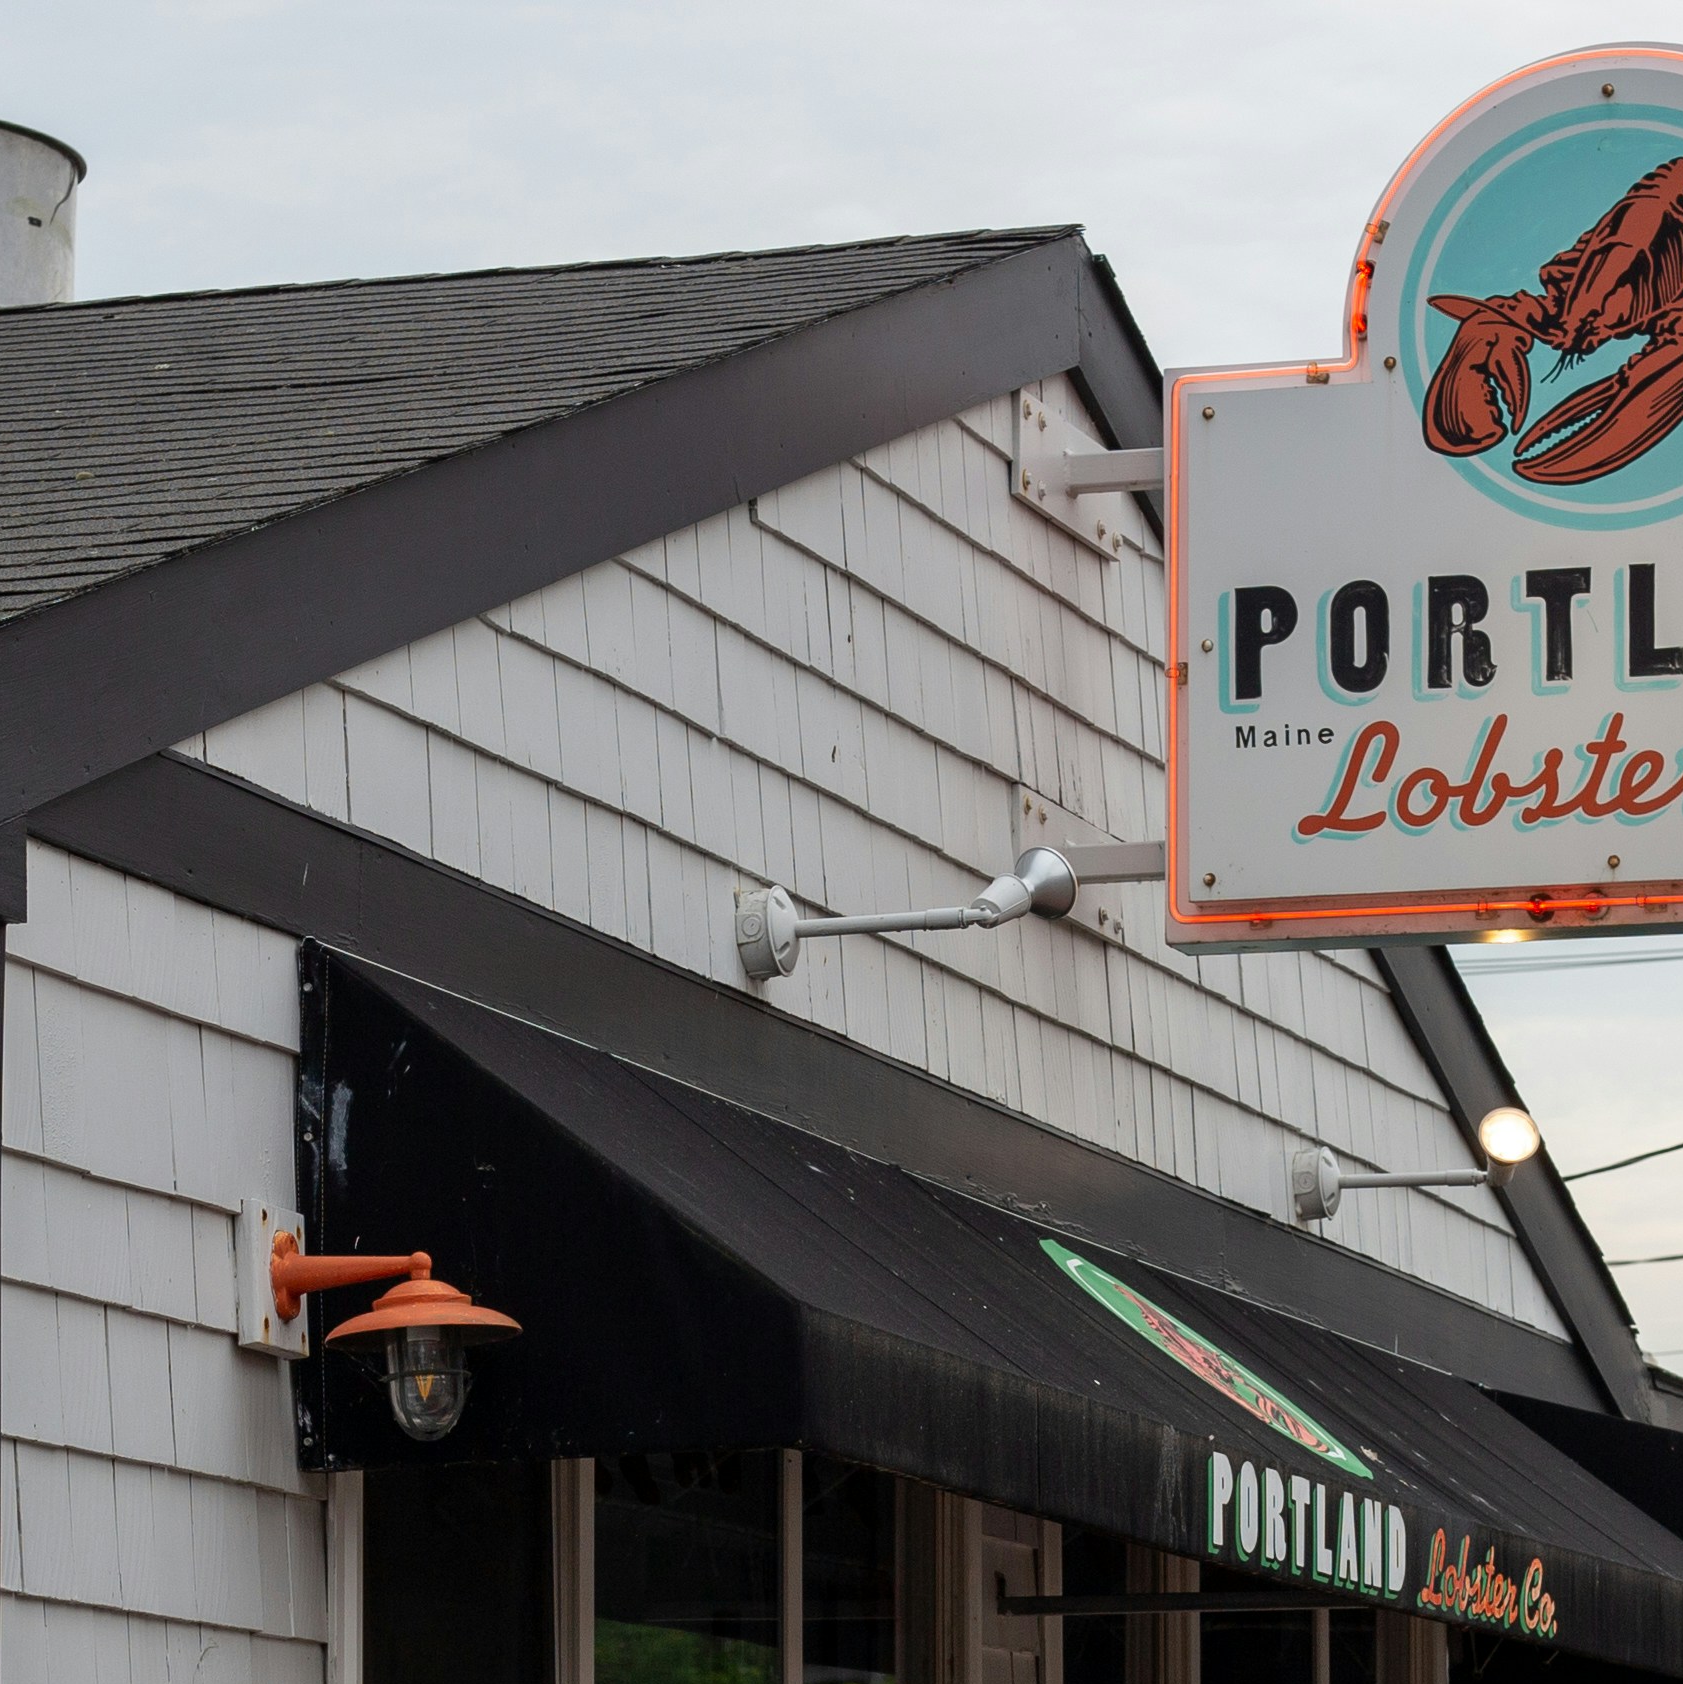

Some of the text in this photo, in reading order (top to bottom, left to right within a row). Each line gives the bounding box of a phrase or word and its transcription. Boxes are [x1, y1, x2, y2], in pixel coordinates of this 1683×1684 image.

[1234, 722, 1336, 750] Maine
[1208, 1451, 1559, 1638] PORTLAND Lobster Co.
